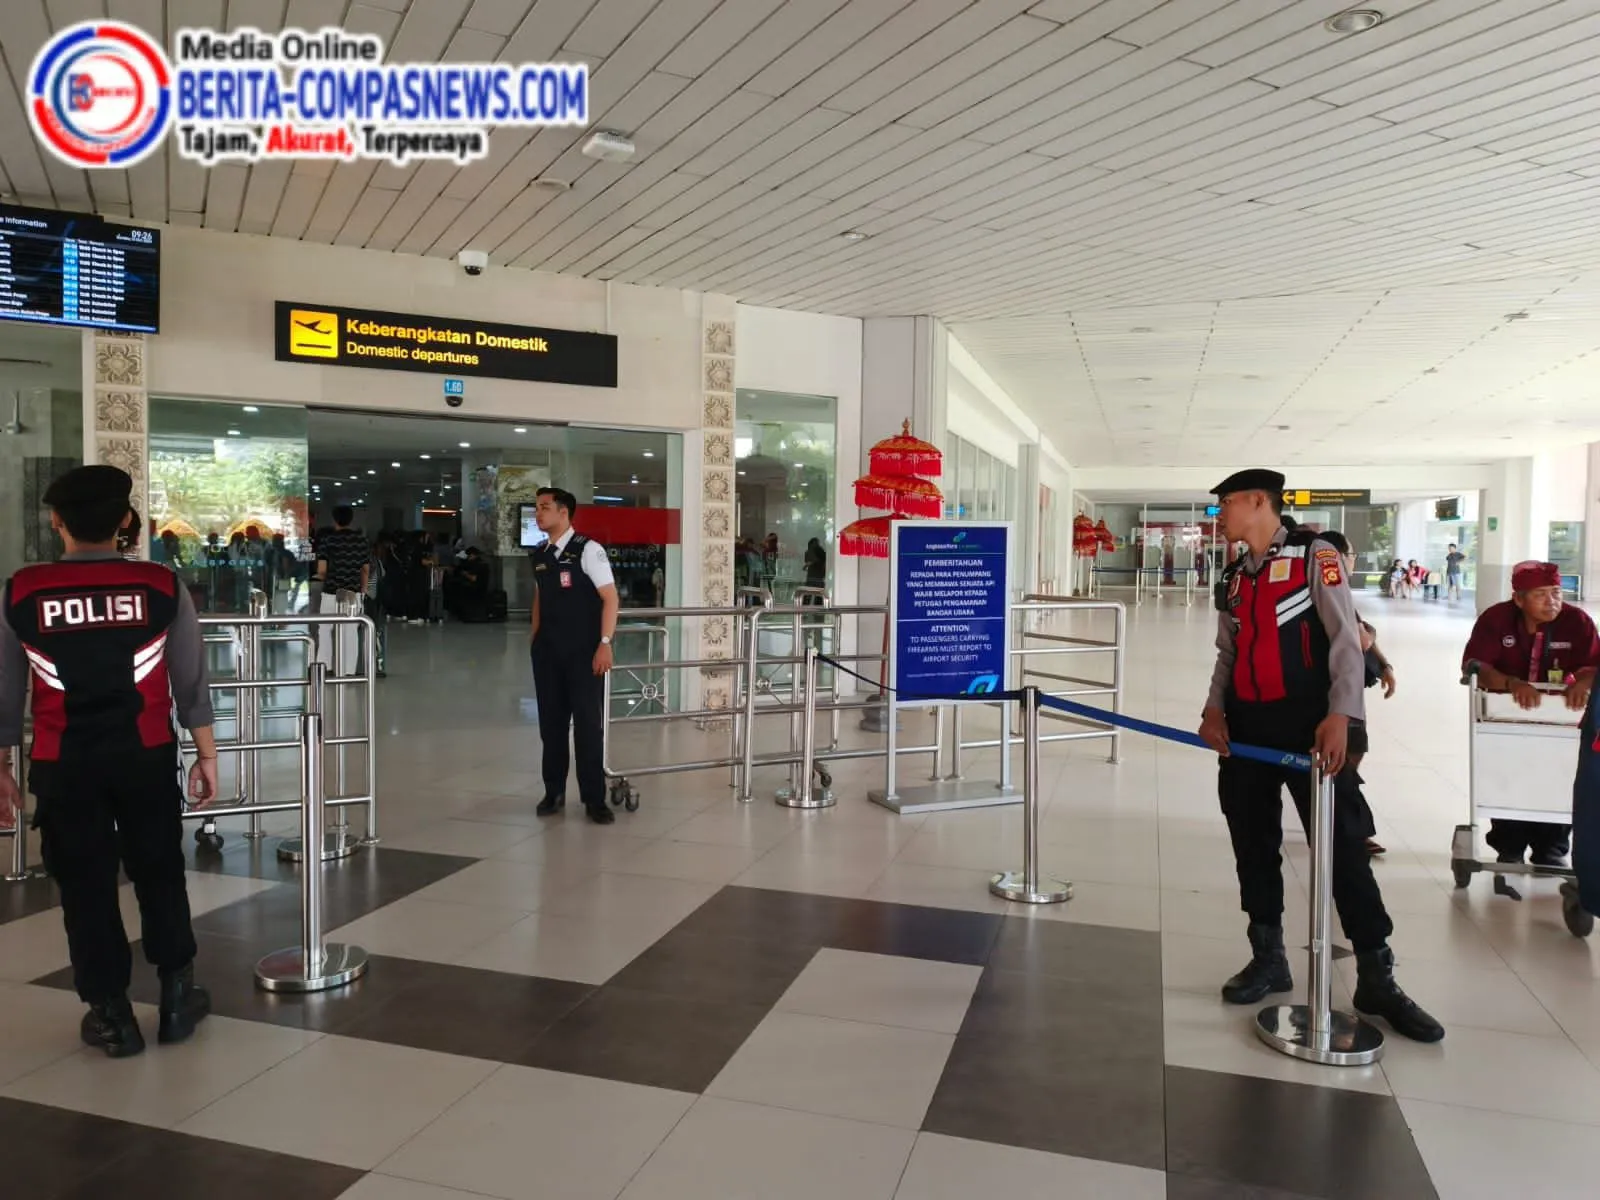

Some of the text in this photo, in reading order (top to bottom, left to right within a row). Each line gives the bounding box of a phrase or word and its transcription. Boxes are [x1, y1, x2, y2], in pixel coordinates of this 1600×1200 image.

[346, 318, 548, 352] Keberangkatan Domestik
[346, 341, 479, 365] Domestic departures
[924, 559, 983, 567] PEMBERITAHUAN
[952, 570, 992, 578] PENUMPANG
[43, 595, 143, 627] POLISI
[926, 609, 953, 617] BANDAR
[931, 624, 970, 633] ATTENTION
[920, 634, 959, 643] PASSENGERS
[959, 633, 990, 641] CARRYING
[940, 644, 958, 652] MUST
[959, 644, 982, 652] REPORT
[923, 654, 979, 663] AIRPORT SECURITY
